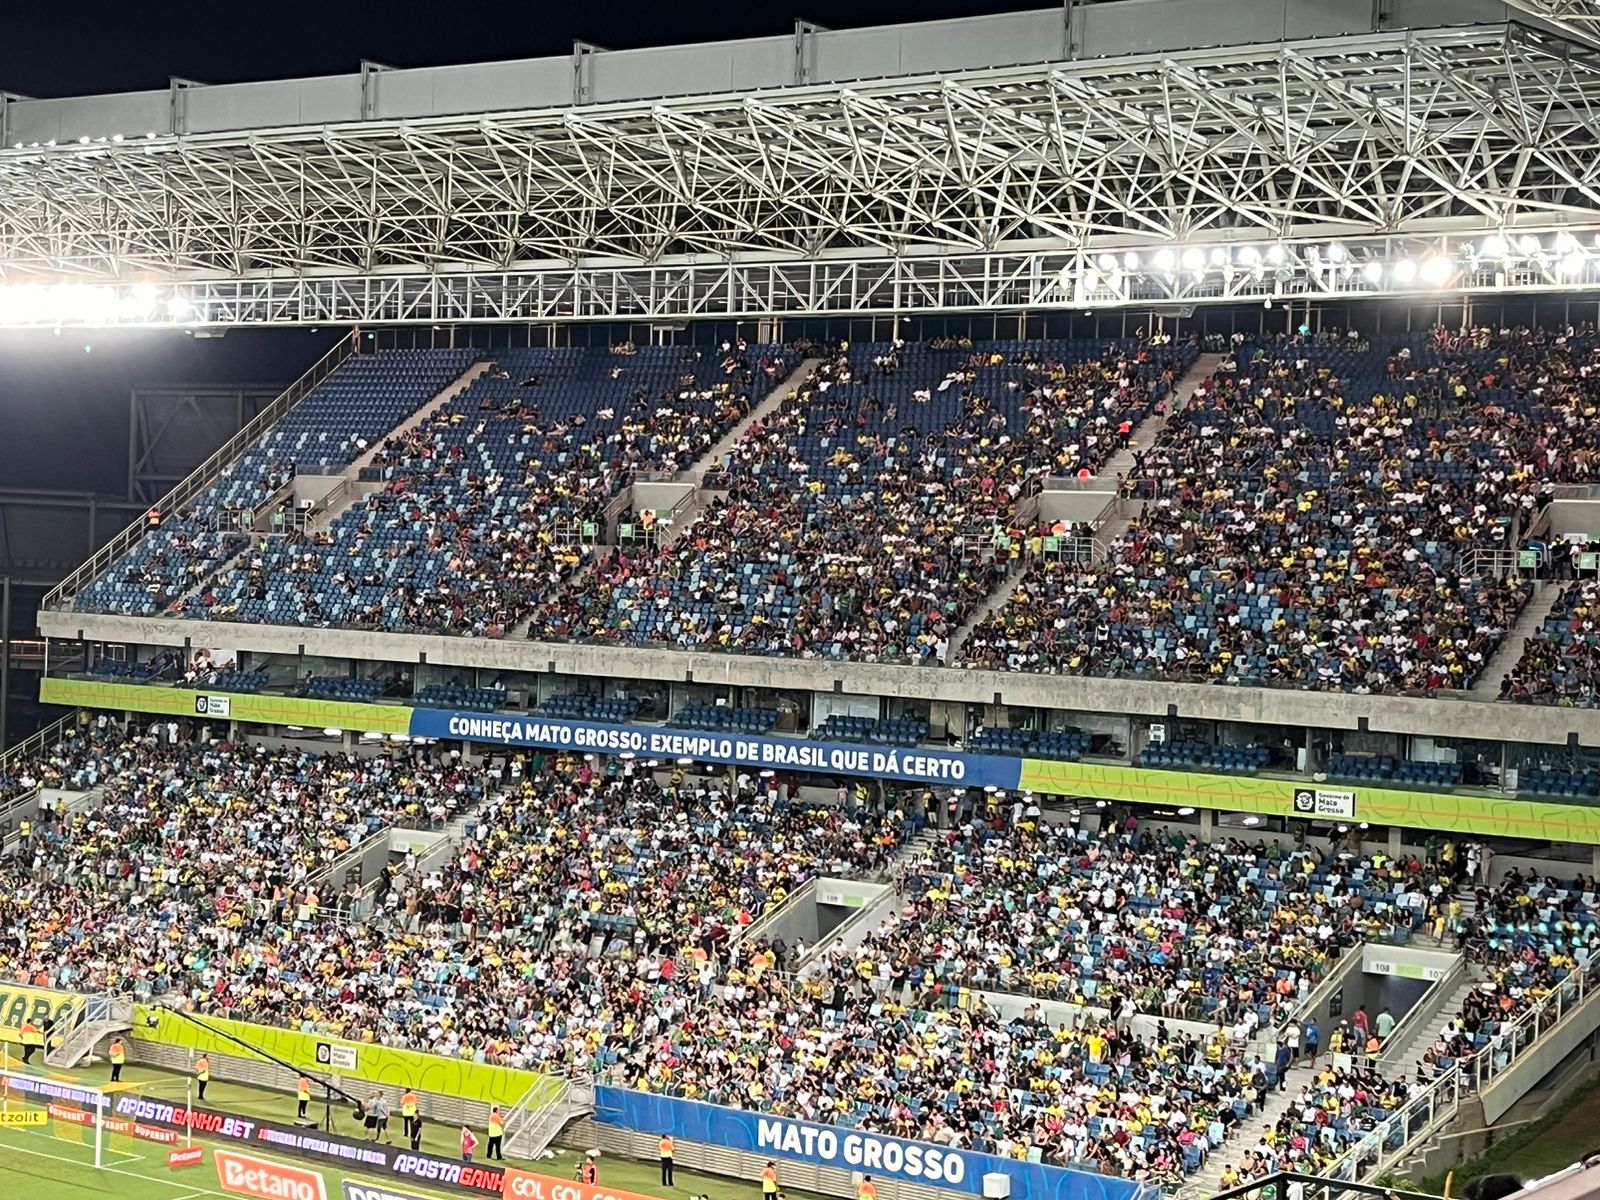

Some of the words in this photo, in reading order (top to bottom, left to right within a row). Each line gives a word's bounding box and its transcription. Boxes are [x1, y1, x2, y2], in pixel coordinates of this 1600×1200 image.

[449, 717, 522, 743] CONHEÇA
[526, 723, 571, 744] MATO
[574, 728, 647, 751] GROSSO:
[650, 734, 732, 759] EXEMPLO
[736, 740, 759, 762] DE
[763, 743, 828, 768] BRASIL
[831, 750, 869, 771] QUE
[873, 749, 899, 774] DÁ
[903, 756, 965, 780] CERTO
[758, 1118, 838, 1160] MATO
[843, 1135, 965, 1184] GROSSO
[224, 1159, 314, 1200] Betano
[512, 1177, 544, 1200] GOL
